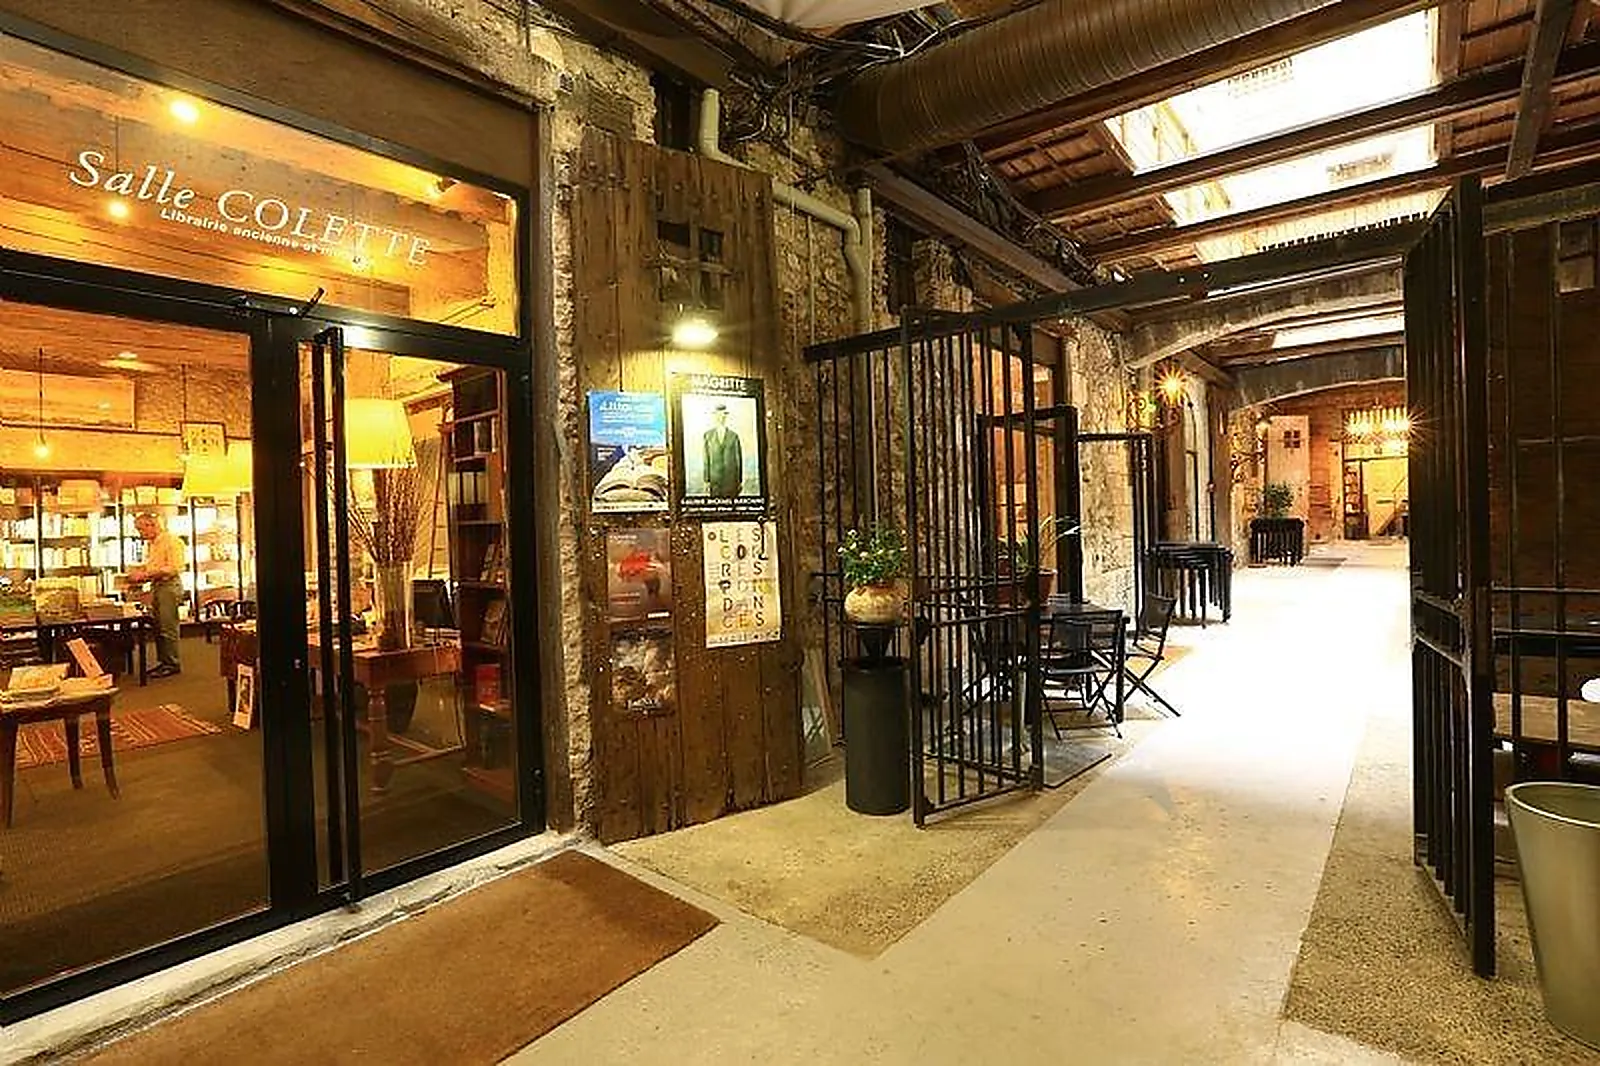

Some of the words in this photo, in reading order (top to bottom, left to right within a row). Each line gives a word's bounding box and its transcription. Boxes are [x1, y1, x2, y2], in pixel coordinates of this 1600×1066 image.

[69, 150, 198, 210] Salle
[216, 189, 434, 266] COLETTE
[160, 207, 228, 233] Librairie
[232, 226, 299, 250] ancienne
